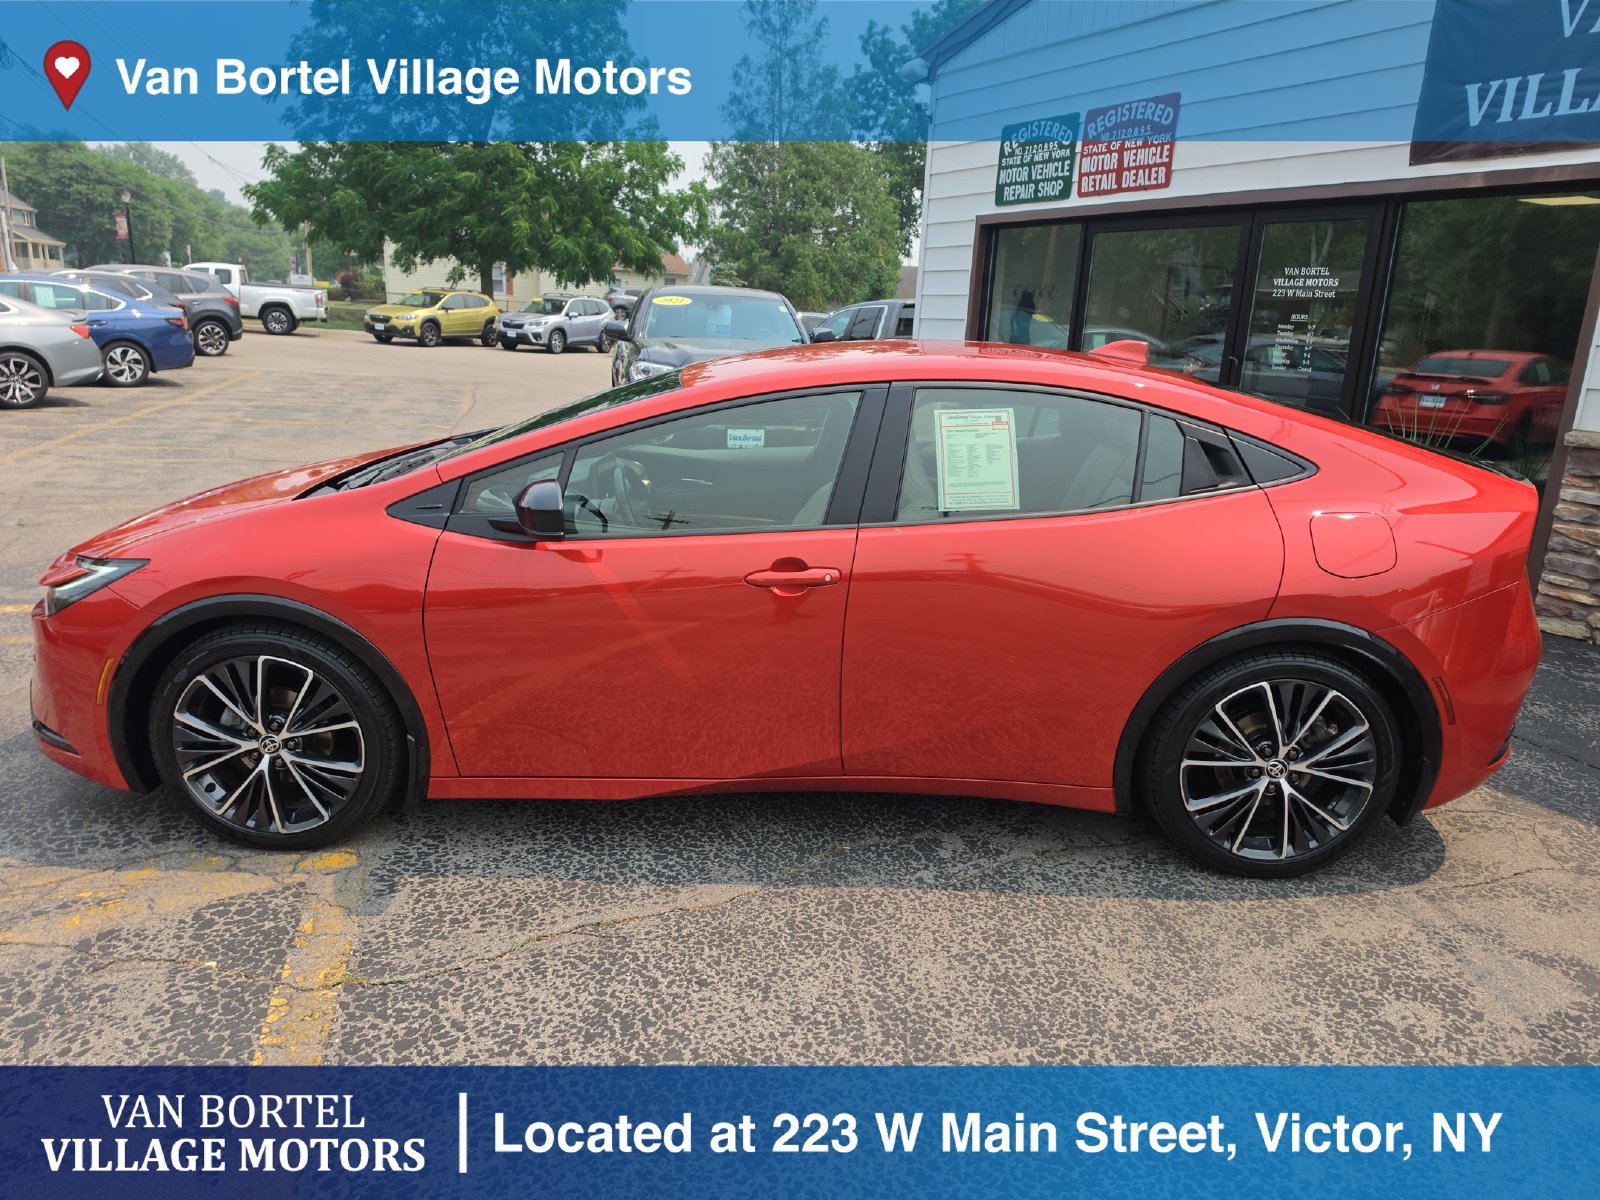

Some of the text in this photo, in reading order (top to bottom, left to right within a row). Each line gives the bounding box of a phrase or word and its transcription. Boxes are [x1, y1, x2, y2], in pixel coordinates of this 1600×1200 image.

[1560, 0, 1600, 38] V
[1465, 67, 1600, 127] VILL
[1087, 101, 1174, 139] REGISTERED
[1003, 120, 1073, 156] REGISTERED
[1083, 132, 1172, 155] STATE OF NEW YORK
[1001, 148, 1071, 167] STATE OF NEW YORK
[1081, 145, 1171, 174] MOTOR VEHICLE
[999, 160, 1071, 185] MOTOR VEHICLE
[1081, 167, 1167, 193] RETAIL DEALER
[1003, 180, 1064, 202] REPAIR SHOP
[1273, 278, 1339, 287] VILLAGE MOTORS
[1284, 267, 1330, 276] VAN BORTEL
[1272, 289, 1336, 298] 223 W Main Street
